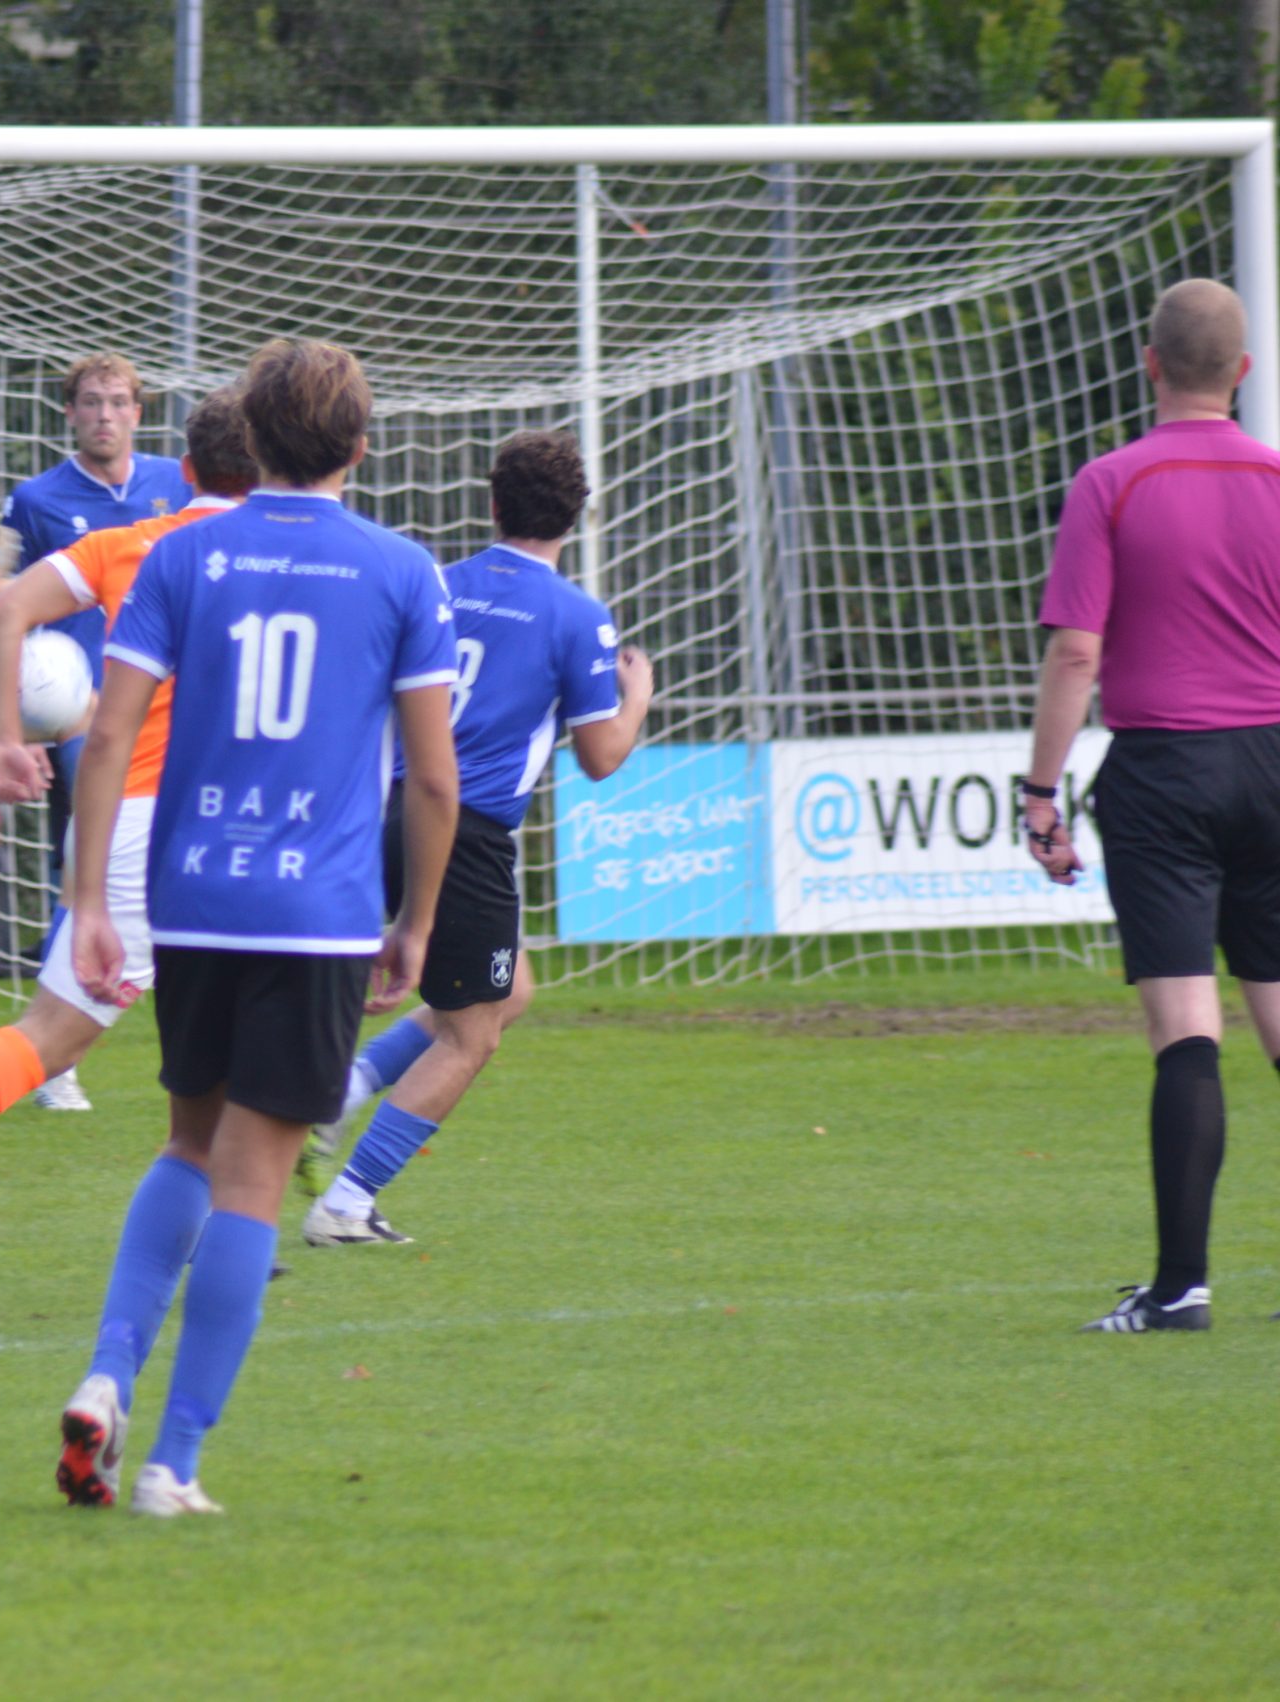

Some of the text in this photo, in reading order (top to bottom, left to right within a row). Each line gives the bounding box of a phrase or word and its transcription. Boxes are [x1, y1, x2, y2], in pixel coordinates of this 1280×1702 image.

[229, 612, 317, 740] 10
[198, 785, 316, 822] BAK
[183, 845, 305, 880] KER
[801, 865, 1107, 903] PERSONEELSDIENE
